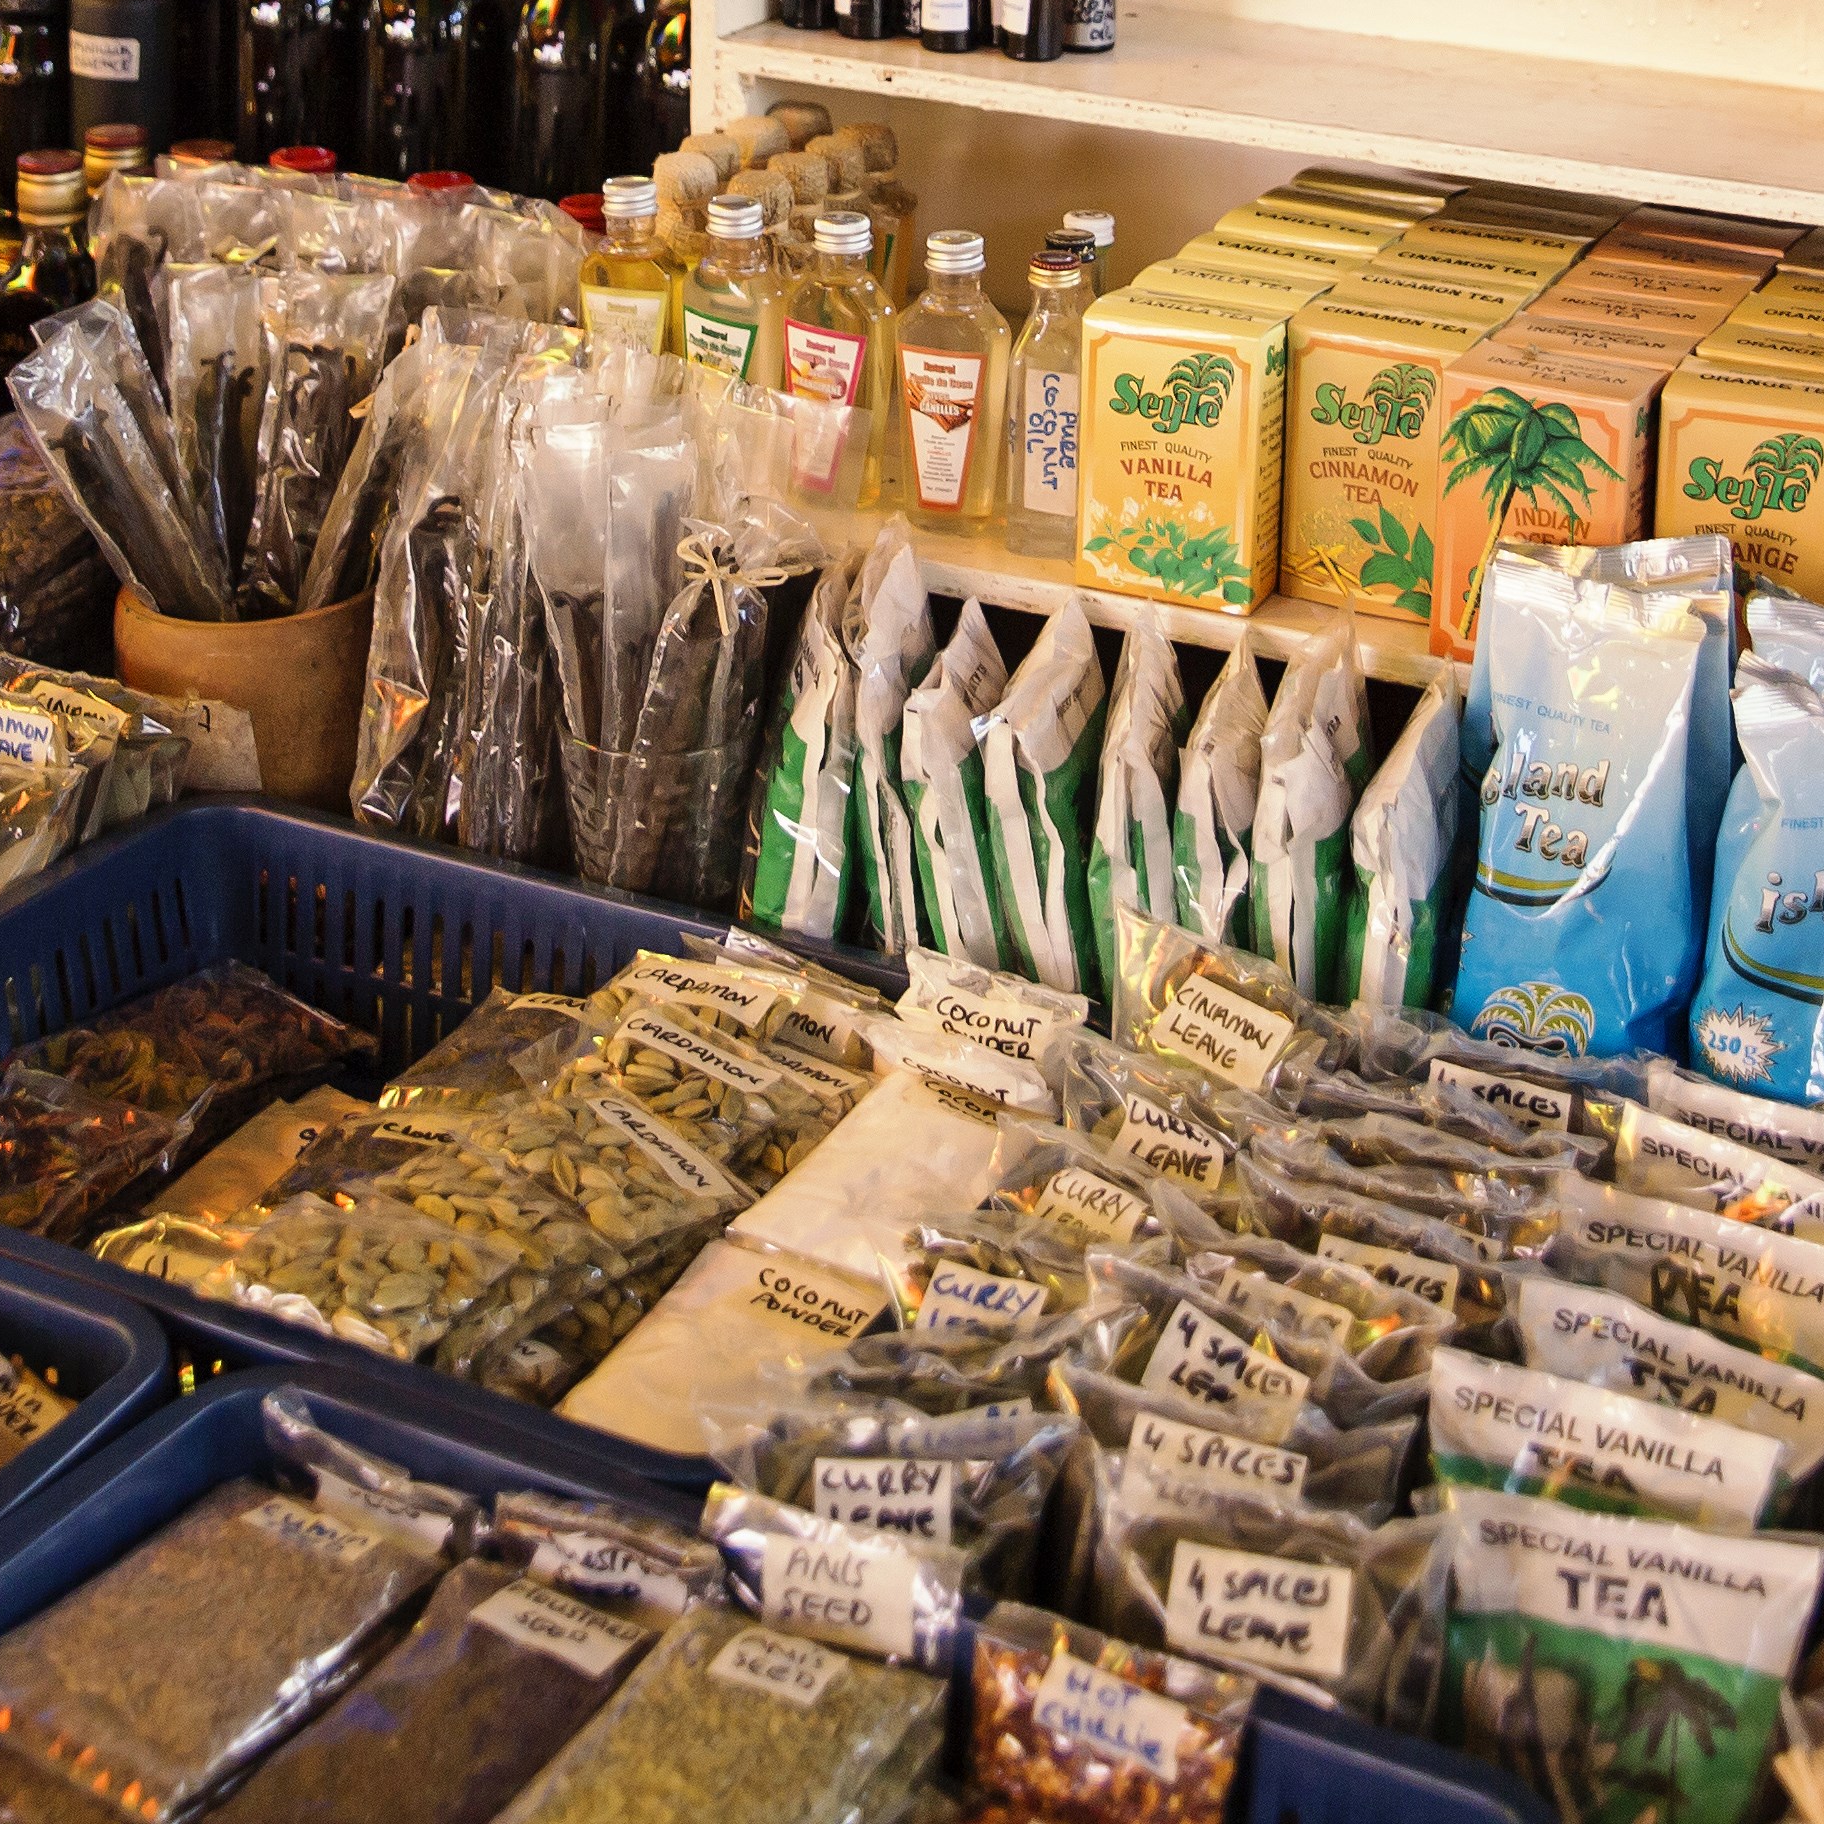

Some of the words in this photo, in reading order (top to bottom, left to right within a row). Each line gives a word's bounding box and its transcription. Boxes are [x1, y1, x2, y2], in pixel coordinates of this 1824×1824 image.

[1254, 210, 1331, 233] VANILLA
[1338, 221, 1372, 237] TEA
[1216, 239, 1291, 261] VANILLA
[1295, 250, 1337, 266] TEA
[1530, 235, 1567, 251] TEA
[1396, 250, 1496, 274] CINNAMON
[1499, 261, 1539, 278] TEA
[1170, 267, 1245, 289] VANILLA
[1249, 277, 1293, 293] TEA
[1360, 275, 1461, 300] CINNAMON
[1464, 289, 1506, 306] TEA
[1125, 295, 1211, 319] VANILLA
[1215, 306, 1255, 323] TEA
[1321, 304, 1427, 329] CINNAMON
[1431, 319, 1469, 336] TEA
[1525, 322, 1593, 343] INDIAN
[1599, 331, 1667, 351] OCEAN
[1735, 337, 1824, 359] ORANGE
[1486, 354, 1553, 375] INDIAN
[1559, 365, 1629, 386] OCEAN
[1697, 372, 1795, 393] ORANGE
[1119, 439, 1158, 455] FINEST
[1164, 442, 1213, 464] QUALITY
[1322, 446, 1360, 461] FINEST
[1367, 448, 1414, 471] QUALITY
[1119, 459, 1214, 490] VANILLA
[1308, 460, 1420, 499] CINNAMON
[1143, 481, 1184, 504] TEA
[1342, 483, 1383, 507] TEA
[1512, 507, 1592, 541] INDIAN
[1693, 522, 1736, 537] FINEST
[1744, 524, 1798, 548] QUALITY
[1730, 542, 1800, 576] ANGE
[1536, 705, 1585, 727] QUALITY
[1589, 718, 1611, 735] TEA
[1480, 753, 1611, 808] sland
[1514, 802, 1589, 869] Tea
[1780, 816, 1824, 832] FINEST
[1707, 1029, 1742, 1055] 250
[1640, 1136, 1756, 1188] SPECIAL
[1587, 1220, 1705, 1262] SPECIAL
[1553, 1307, 1676, 1366] SPECIAL
[1686, 1353, 1808, 1422] VANILLA
[1621, 1356, 1719, 1416] TEA
[1452, 1385, 1584, 1444] SPECIAL
[1594, 1423, 1725, 1484] VANILLA
[821, 1458, 944, 1497] CURRY
[1478, 1516, 1613, 1567] SPECIAL
[1626, 1547, 1767, 1598] VANILLA
[1188, 1560, 1207, 1600] 4
[780, 1588, 874, 1629] SEED
[1557, 1569, 1669, 1628] TEA
